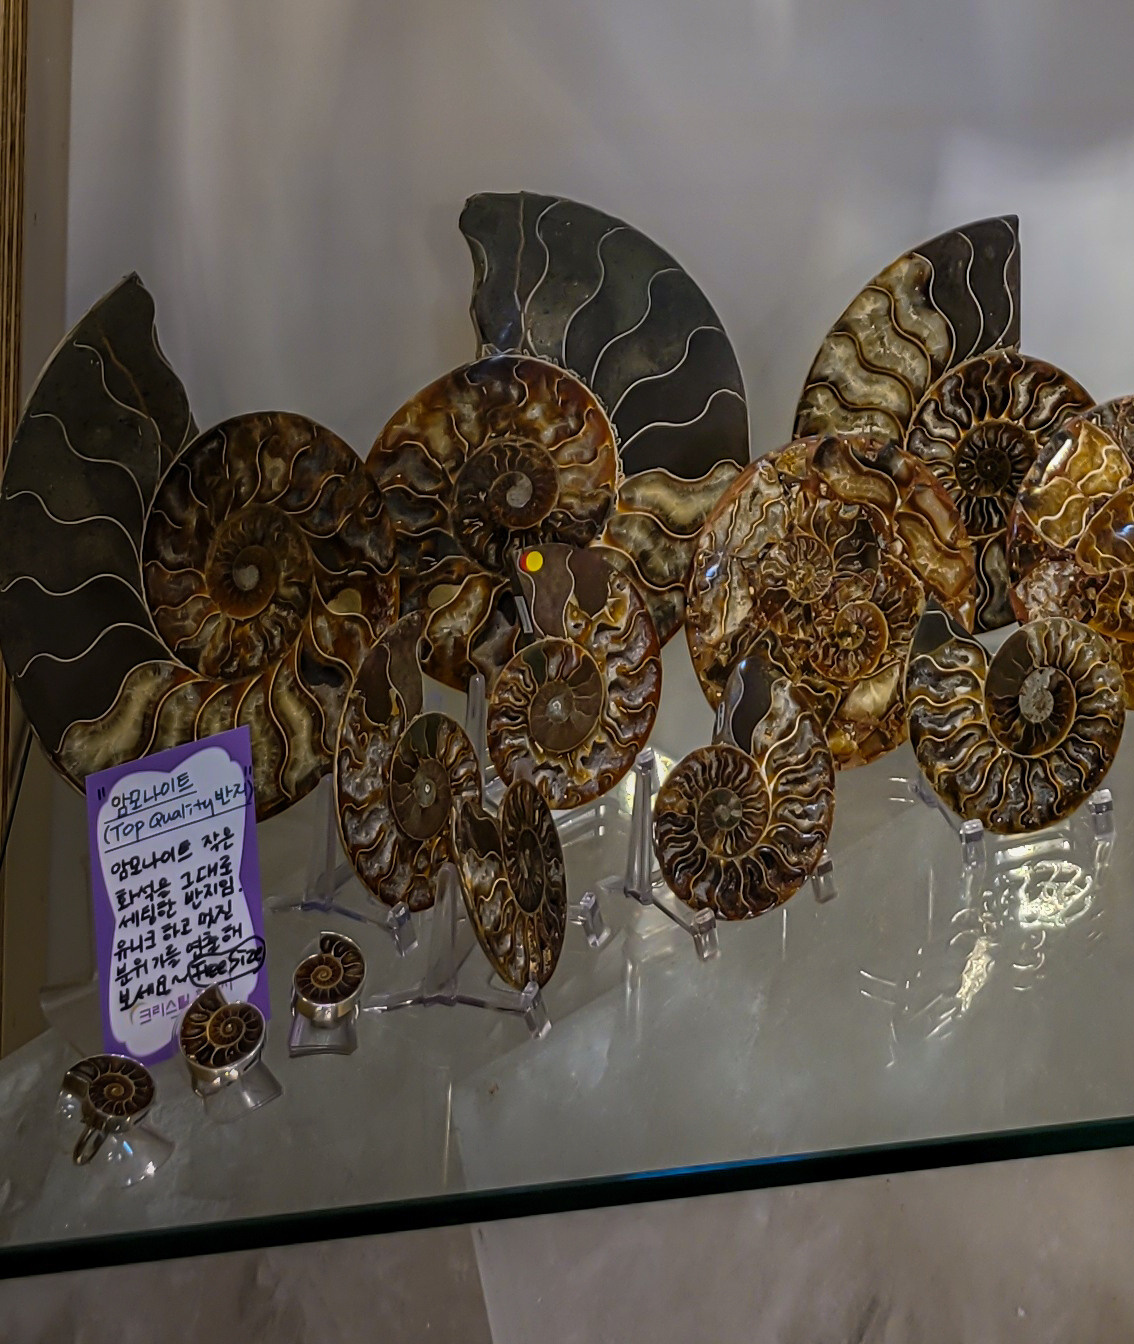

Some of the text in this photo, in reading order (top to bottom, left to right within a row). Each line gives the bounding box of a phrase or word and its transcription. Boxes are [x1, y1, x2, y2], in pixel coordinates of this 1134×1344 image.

[110, 826, 235, 882] 암모나이트 작은
[180, 854, 233, 891] 그대로
